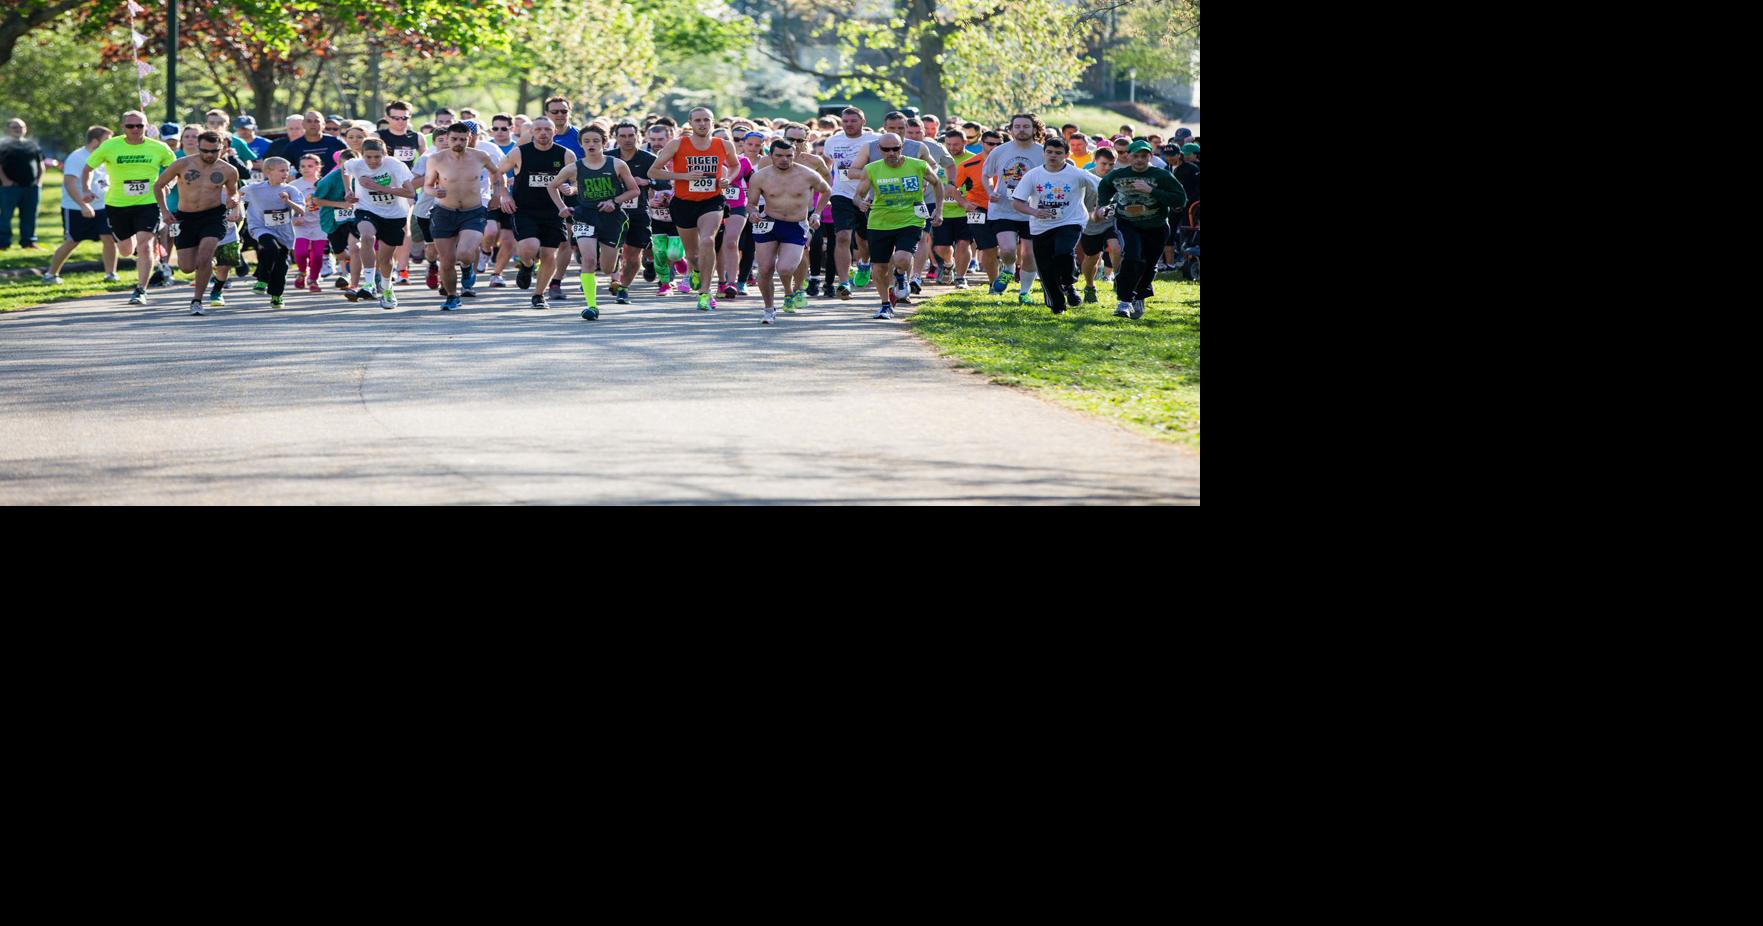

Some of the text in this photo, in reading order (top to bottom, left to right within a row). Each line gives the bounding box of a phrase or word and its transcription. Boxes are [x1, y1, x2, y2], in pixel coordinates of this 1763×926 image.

[686, 156, 718, 164] TIGER
[584, 176, 615, 192] RUN
[372, 194, 395, 202] 1111
[272, 212, 285, 221] 53
